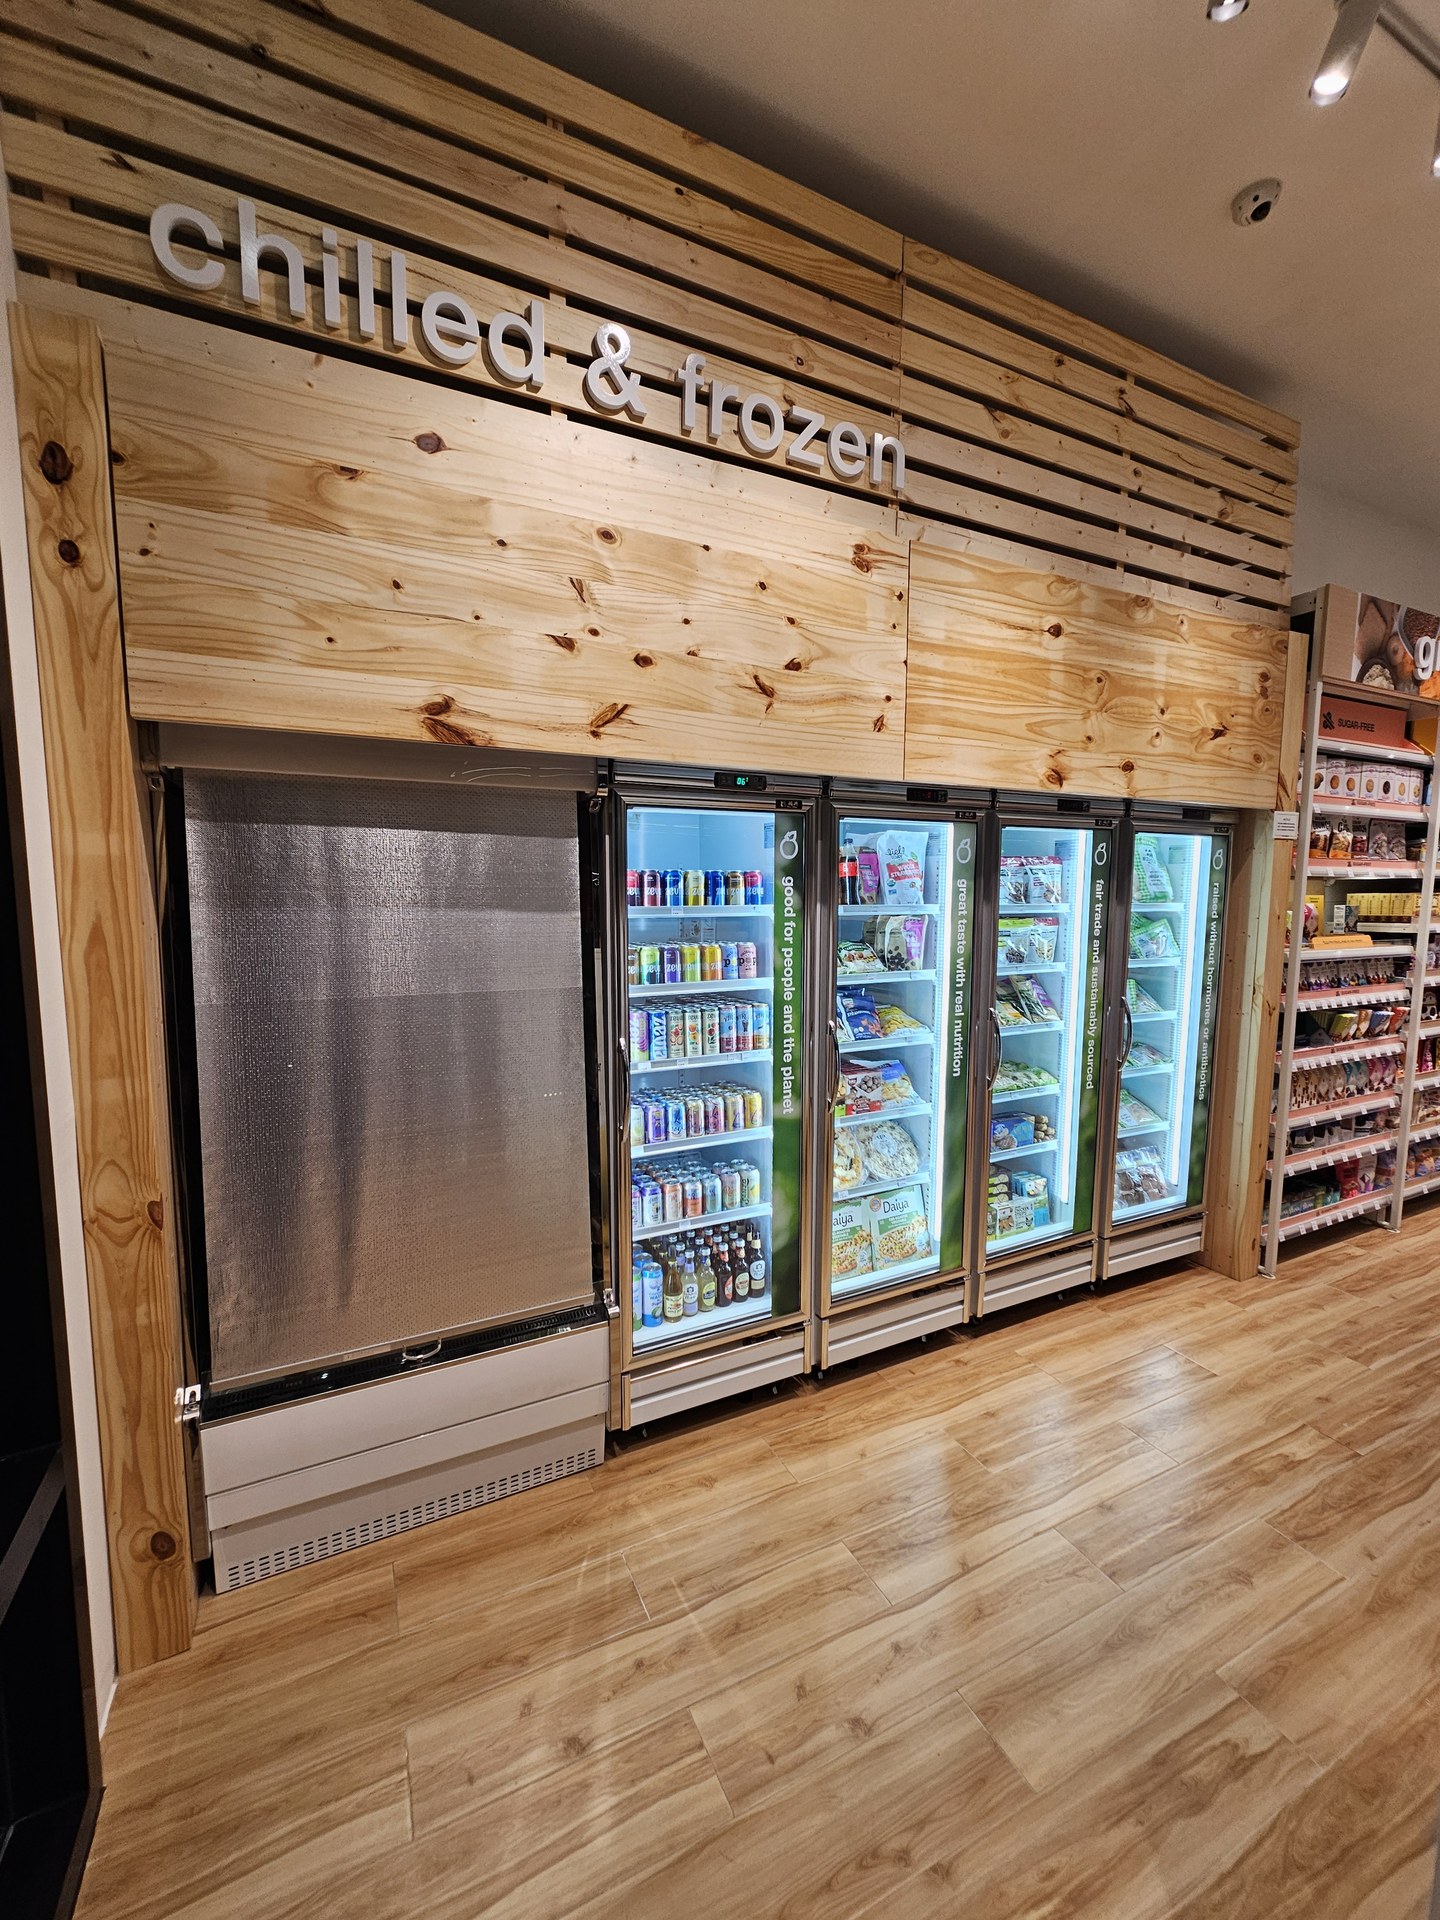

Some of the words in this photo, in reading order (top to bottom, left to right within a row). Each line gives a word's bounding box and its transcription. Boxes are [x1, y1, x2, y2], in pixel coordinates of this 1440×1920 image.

[149, 199, 545, 390] chilled
[584, 322, 648, 420] &
[677, 353, 906, 492] frozen
[1337, 718, 1376, 733] SUGAR-FREE
[781, 876, 796, 918] good
[956, 878, 968, 916] great
[1094, 878, 1105, 900] fair
[1210, 882, 1221, 919] raised
[783, 920, 796, 944] for
[957, 918, 968, 954] taste
[1093, 902, 1104, 937] trade
[1091, 939, 1103, 964] and
[1207, 920, 1219, 965] without
[780, 947, 796, 1002] people
[955, 957, 967, 988] with
[954, 990, 966, 1017] real
[1087, 966, 1102, 1037] sustainably
[1203, 967, 1216, 1025] hormones
[783, 1004, 796, 1035] and
[1202, 1027, 1211, 1041] or
[782, 1036, 796, 1063] the
[952, 1019, 965, 1077] nutrition
[1085, 1039, 1096, 1090] sourced
[1198, 1042, 1211, 1101] antibiotics
[780, 1066, 797, 1115] planet
[832, 1212, 854, 1228] aiya
[882, 1198, 910, 1214] Daiya
